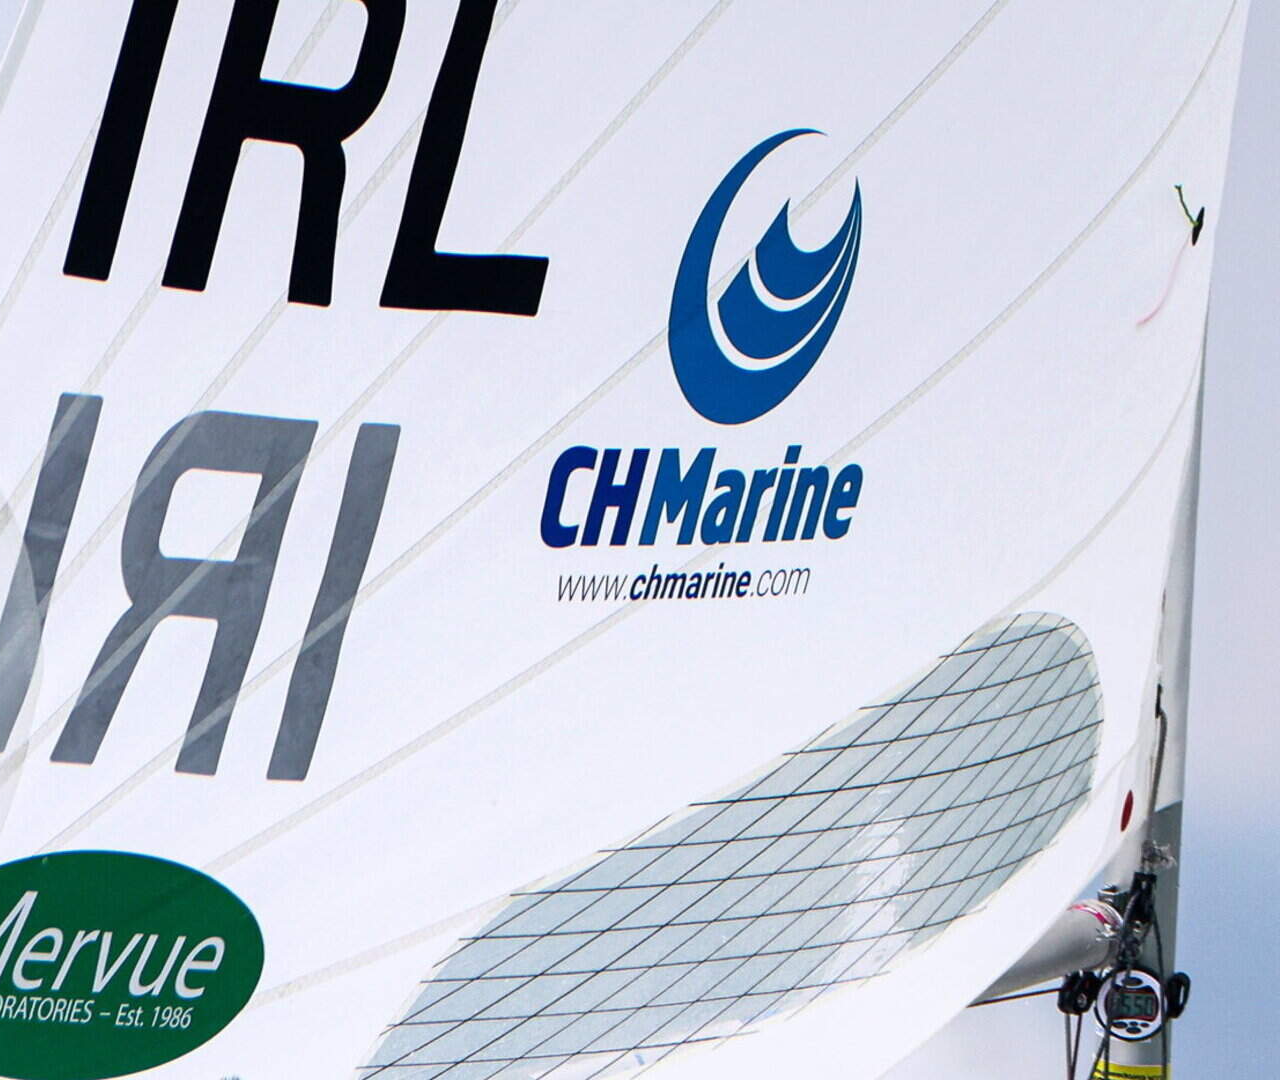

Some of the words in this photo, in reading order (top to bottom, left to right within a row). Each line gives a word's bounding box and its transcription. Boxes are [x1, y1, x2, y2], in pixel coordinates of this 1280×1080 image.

[62, 0, 549, 317] IRL
[557, 562, 811, 602] www.chmarine.com
[115, 1003, 145, 1027] Est.
[151, 1005, 194, 1029] 1986
